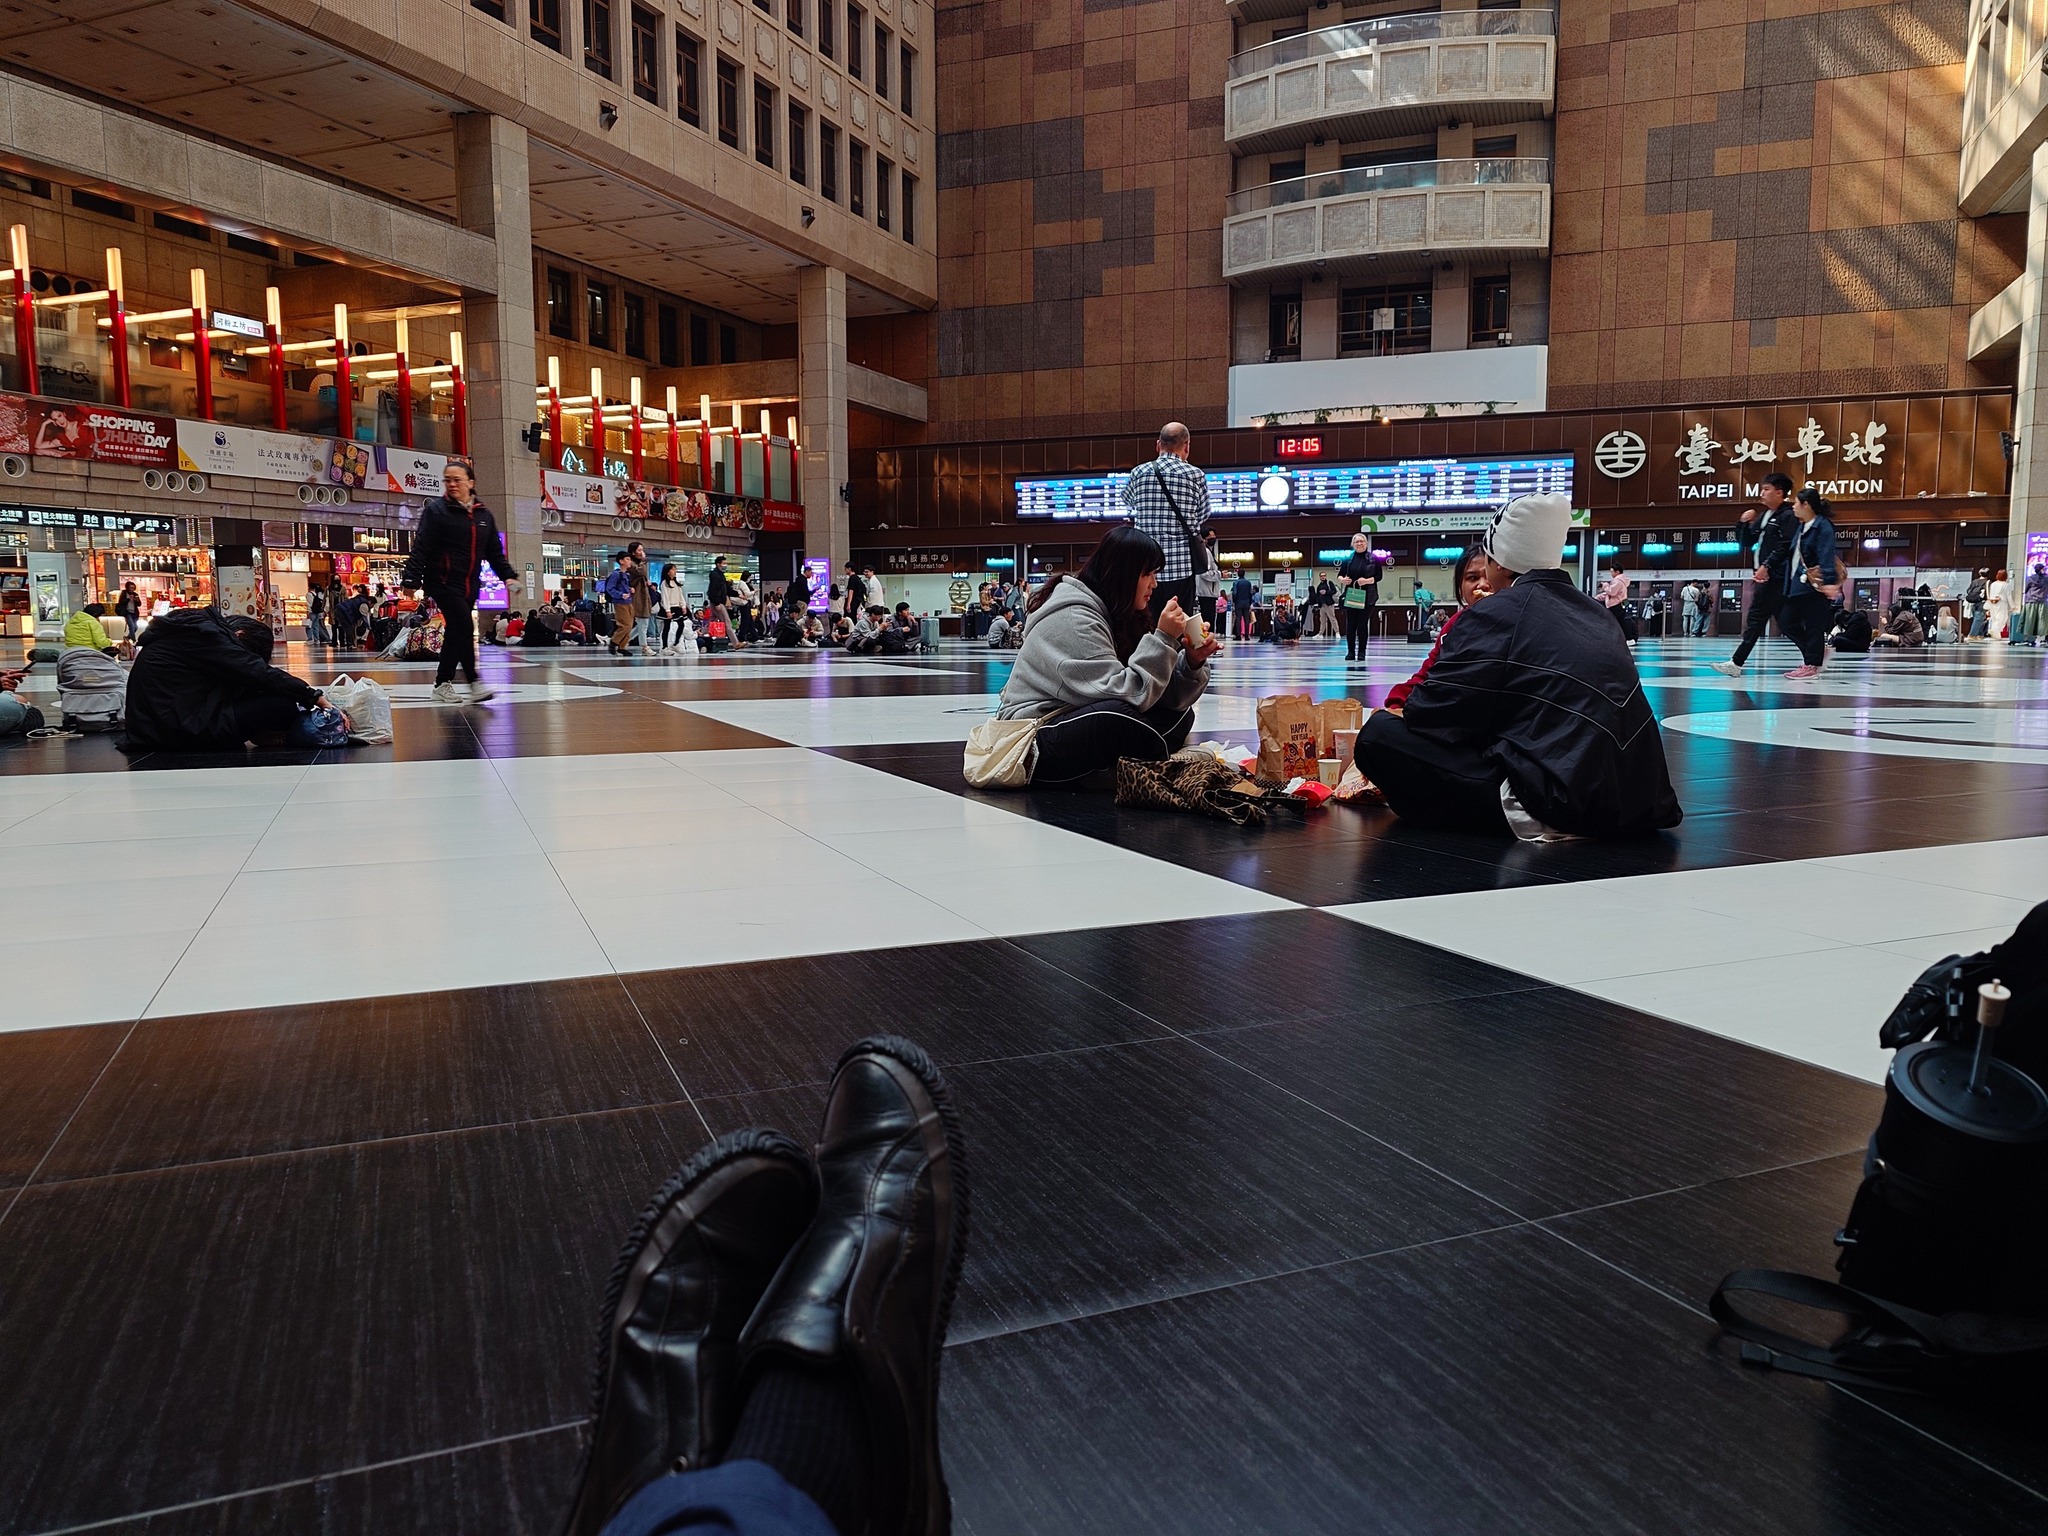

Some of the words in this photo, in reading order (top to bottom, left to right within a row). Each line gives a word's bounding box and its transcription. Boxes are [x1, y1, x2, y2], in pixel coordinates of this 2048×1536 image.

[89, 414, 156, 433] SHOPPING
[102, 429, 171, 449] THURSDAY
[1281, 437, 1320, 453] 12:05
[1675, 417, 1887, 475] 臺北車站
[1679, 483, 1733, 499] TAIPEI
[83, 514, 99, 524] 月台
[1391, 518, 1429, 527] TPASS
[361, 534, 390, 545] Breeze
[1619, 531, 1737, 544] 自動售票機
[1835, 530, 1859, 540] nding
[1864, 529, 1899, 539] Machine
[1290, 722, 1308, 734] HAPPY
